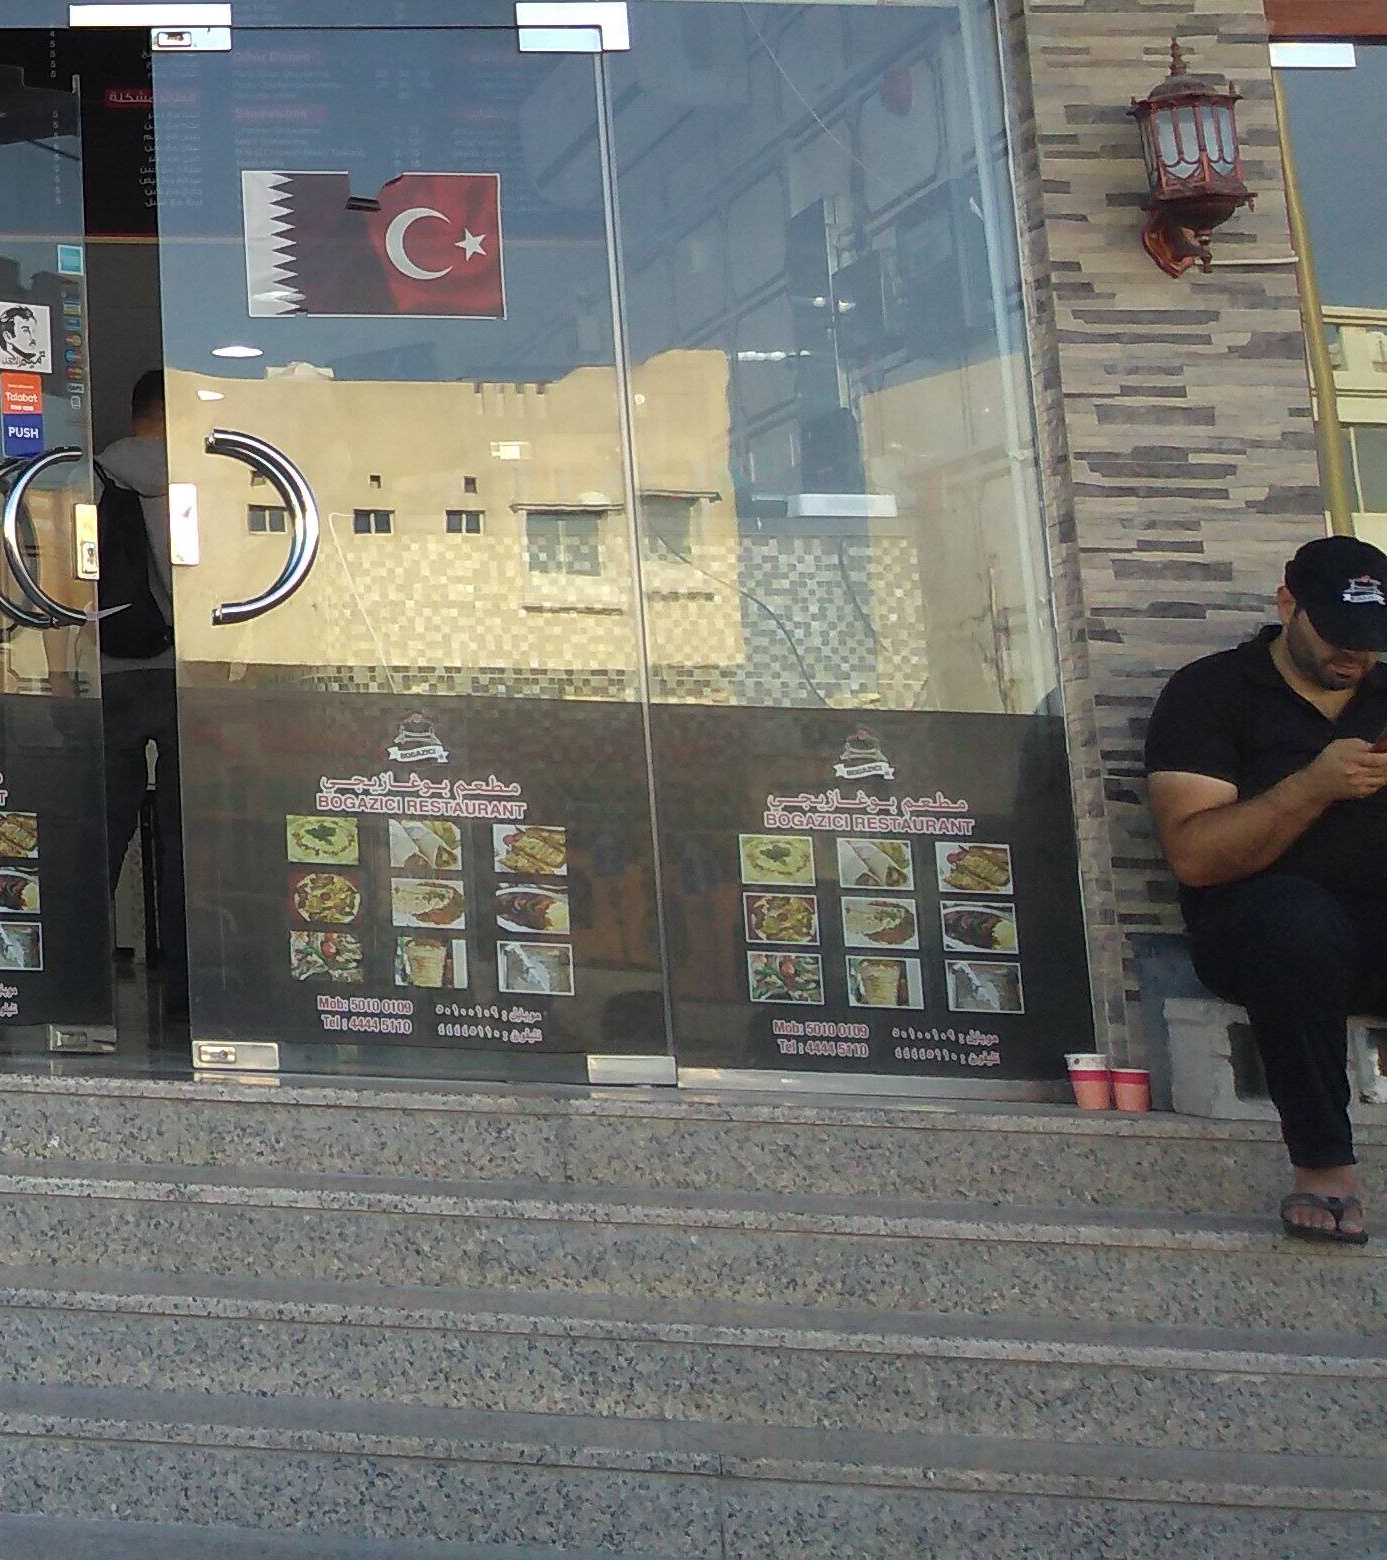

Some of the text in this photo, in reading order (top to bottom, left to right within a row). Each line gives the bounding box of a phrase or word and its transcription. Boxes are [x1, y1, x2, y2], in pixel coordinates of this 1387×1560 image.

[8, 426, 40, 439] PUSH
[453, 774, 522, 804] مطعم
[315, 792, 528, 820] BOGAZICI RESTAURANT
[901, 791, 969, 820] مطعم
[763, 810, 976, 836] BOGAZICI RESTAURANT
[349, 996, 381, 1013] 5010
[381, 998, 414, 1015] 0109
[348, 1016, 381, 1033] 4444
[380, 1018, 413, 1035] 5110
[804, 1021, 837, 1037] 5010
[836, 1023, 870, 1039] 0109
[804, 1040, 837, 1057] 4444
[836, 1041, 870, 1059] 5110
